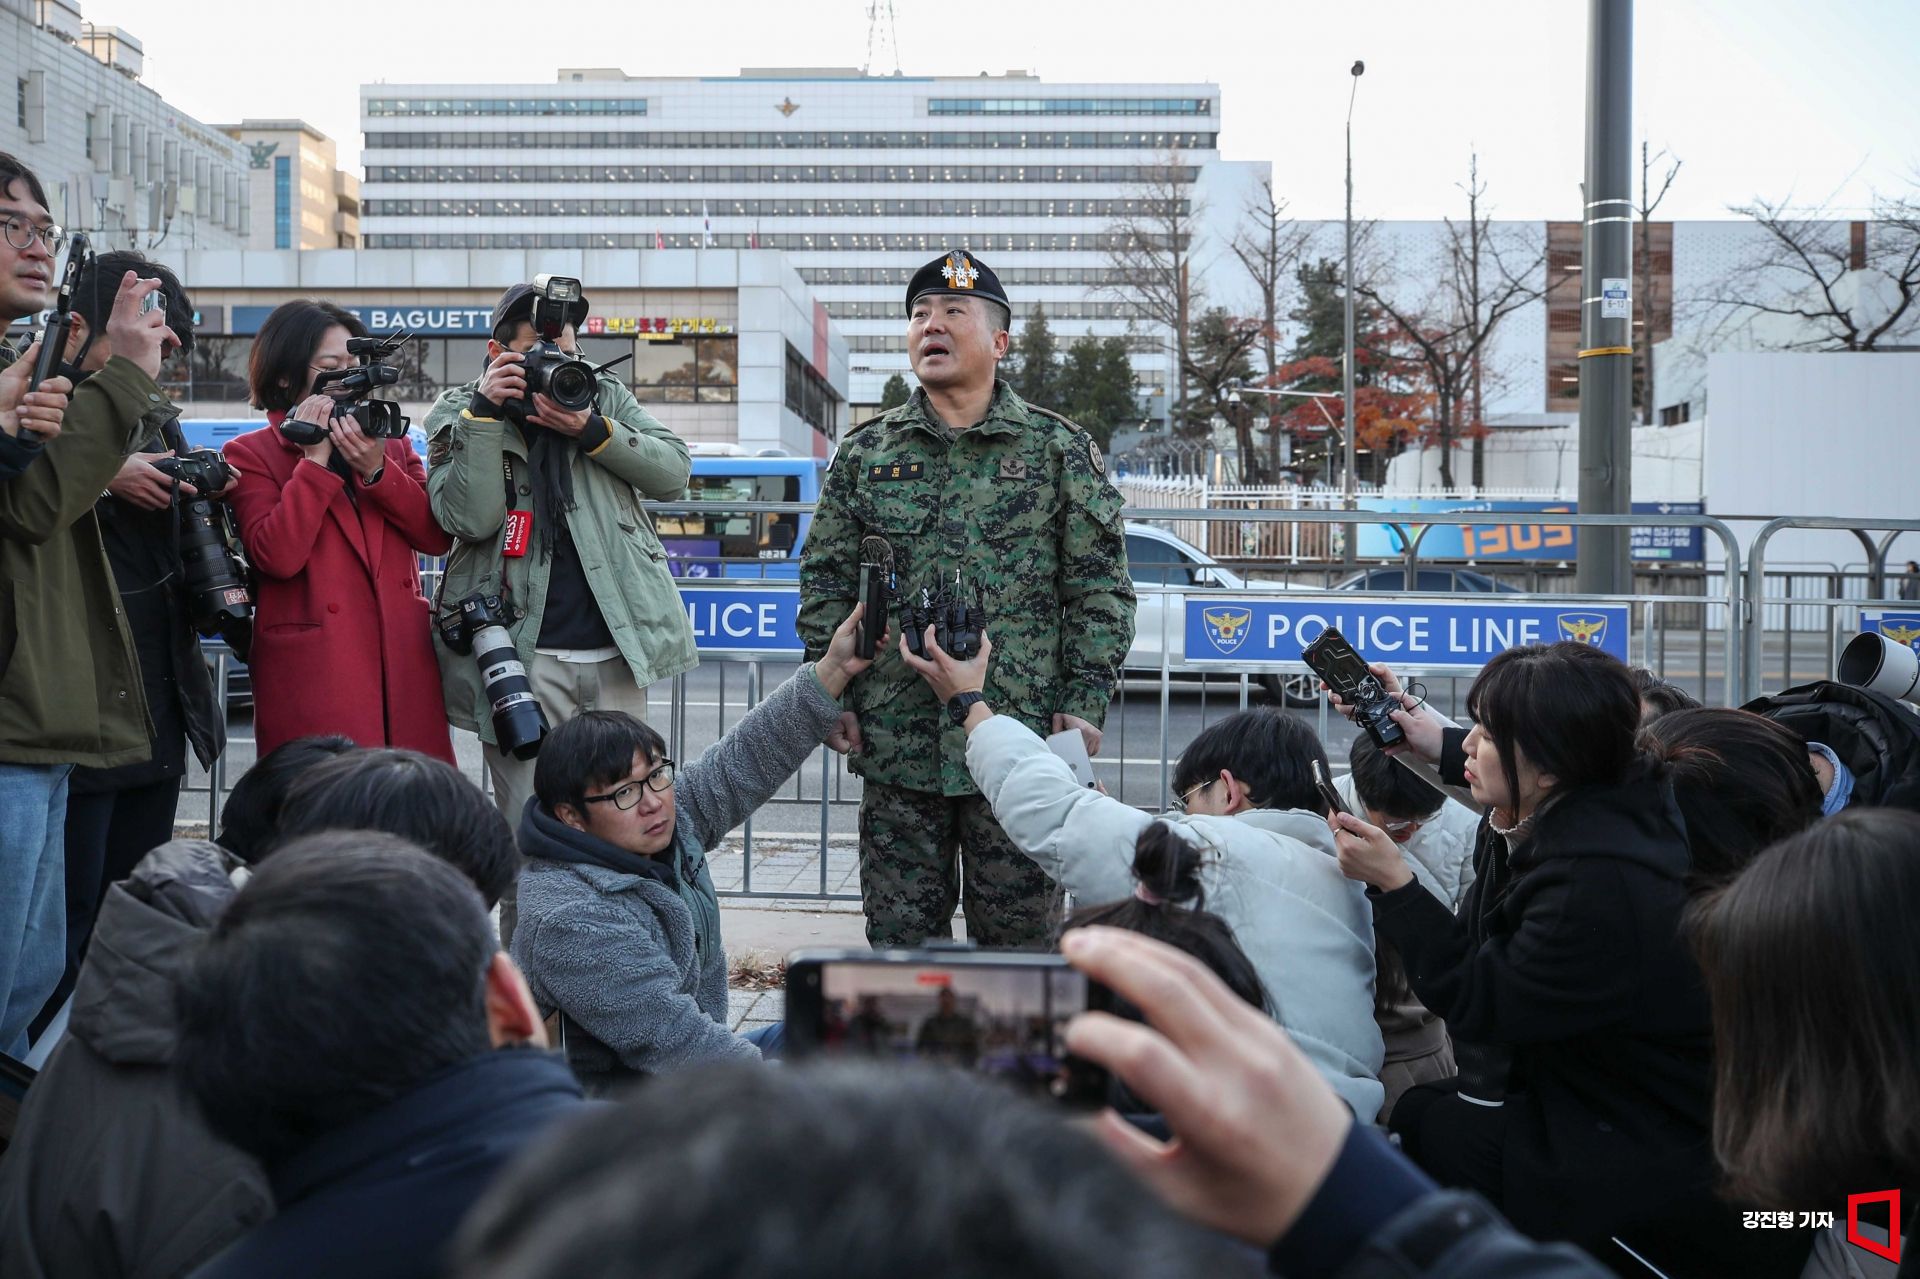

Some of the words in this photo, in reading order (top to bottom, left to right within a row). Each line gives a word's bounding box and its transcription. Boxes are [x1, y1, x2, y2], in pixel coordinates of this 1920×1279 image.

[371, 310, 494, 329] BAGUETT
[503, 514, 518, 551] PRESS
[688, 602, 777, 638] LICE
